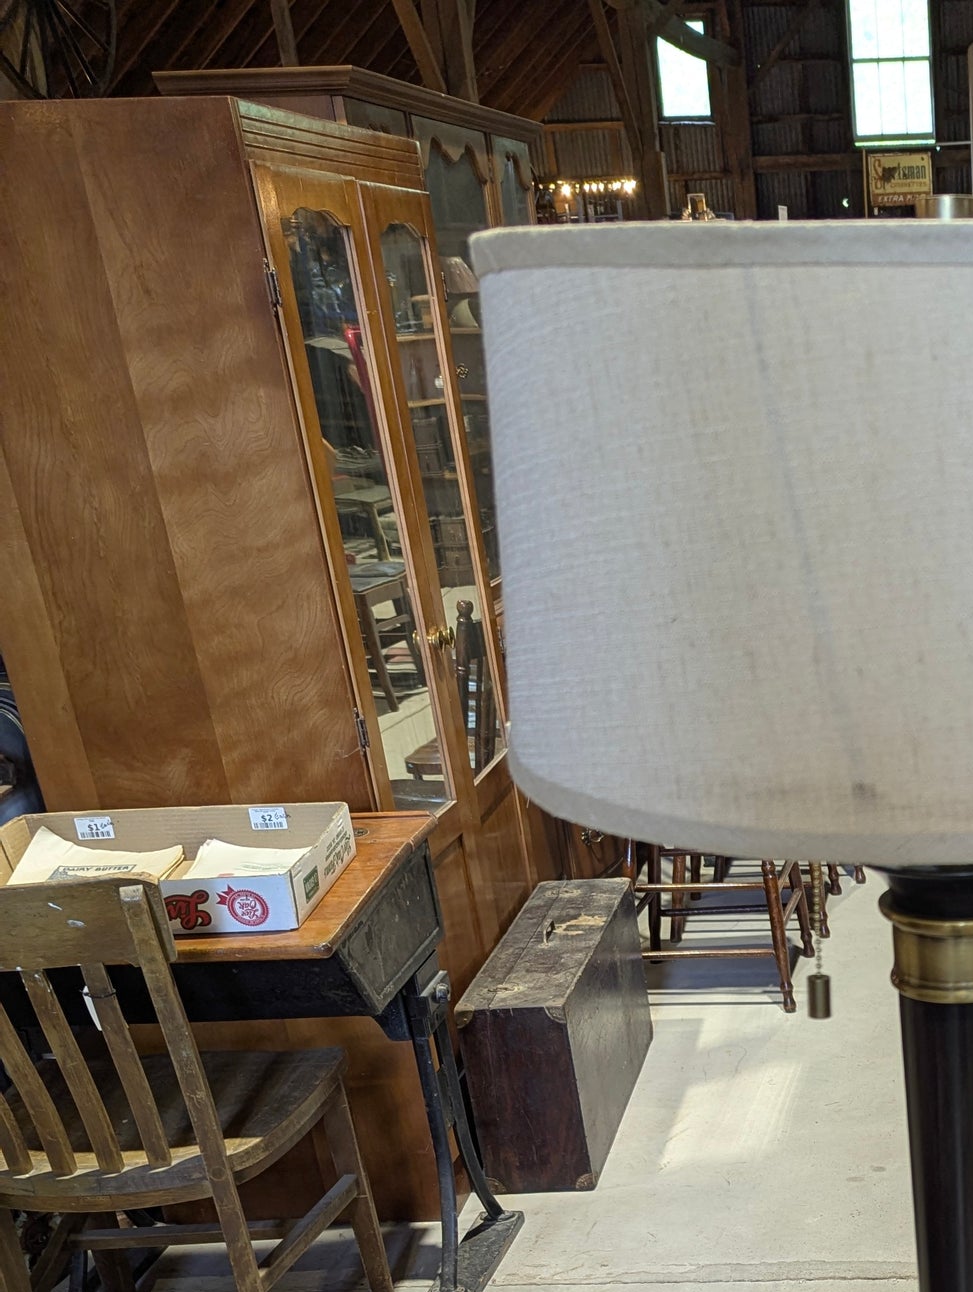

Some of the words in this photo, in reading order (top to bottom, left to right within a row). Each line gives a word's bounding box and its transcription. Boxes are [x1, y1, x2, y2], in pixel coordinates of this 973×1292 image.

[878, 194, 905, 203] EXTRA
[261, 814, 274, 823] $2
[87, 823, 101, 832] $1
